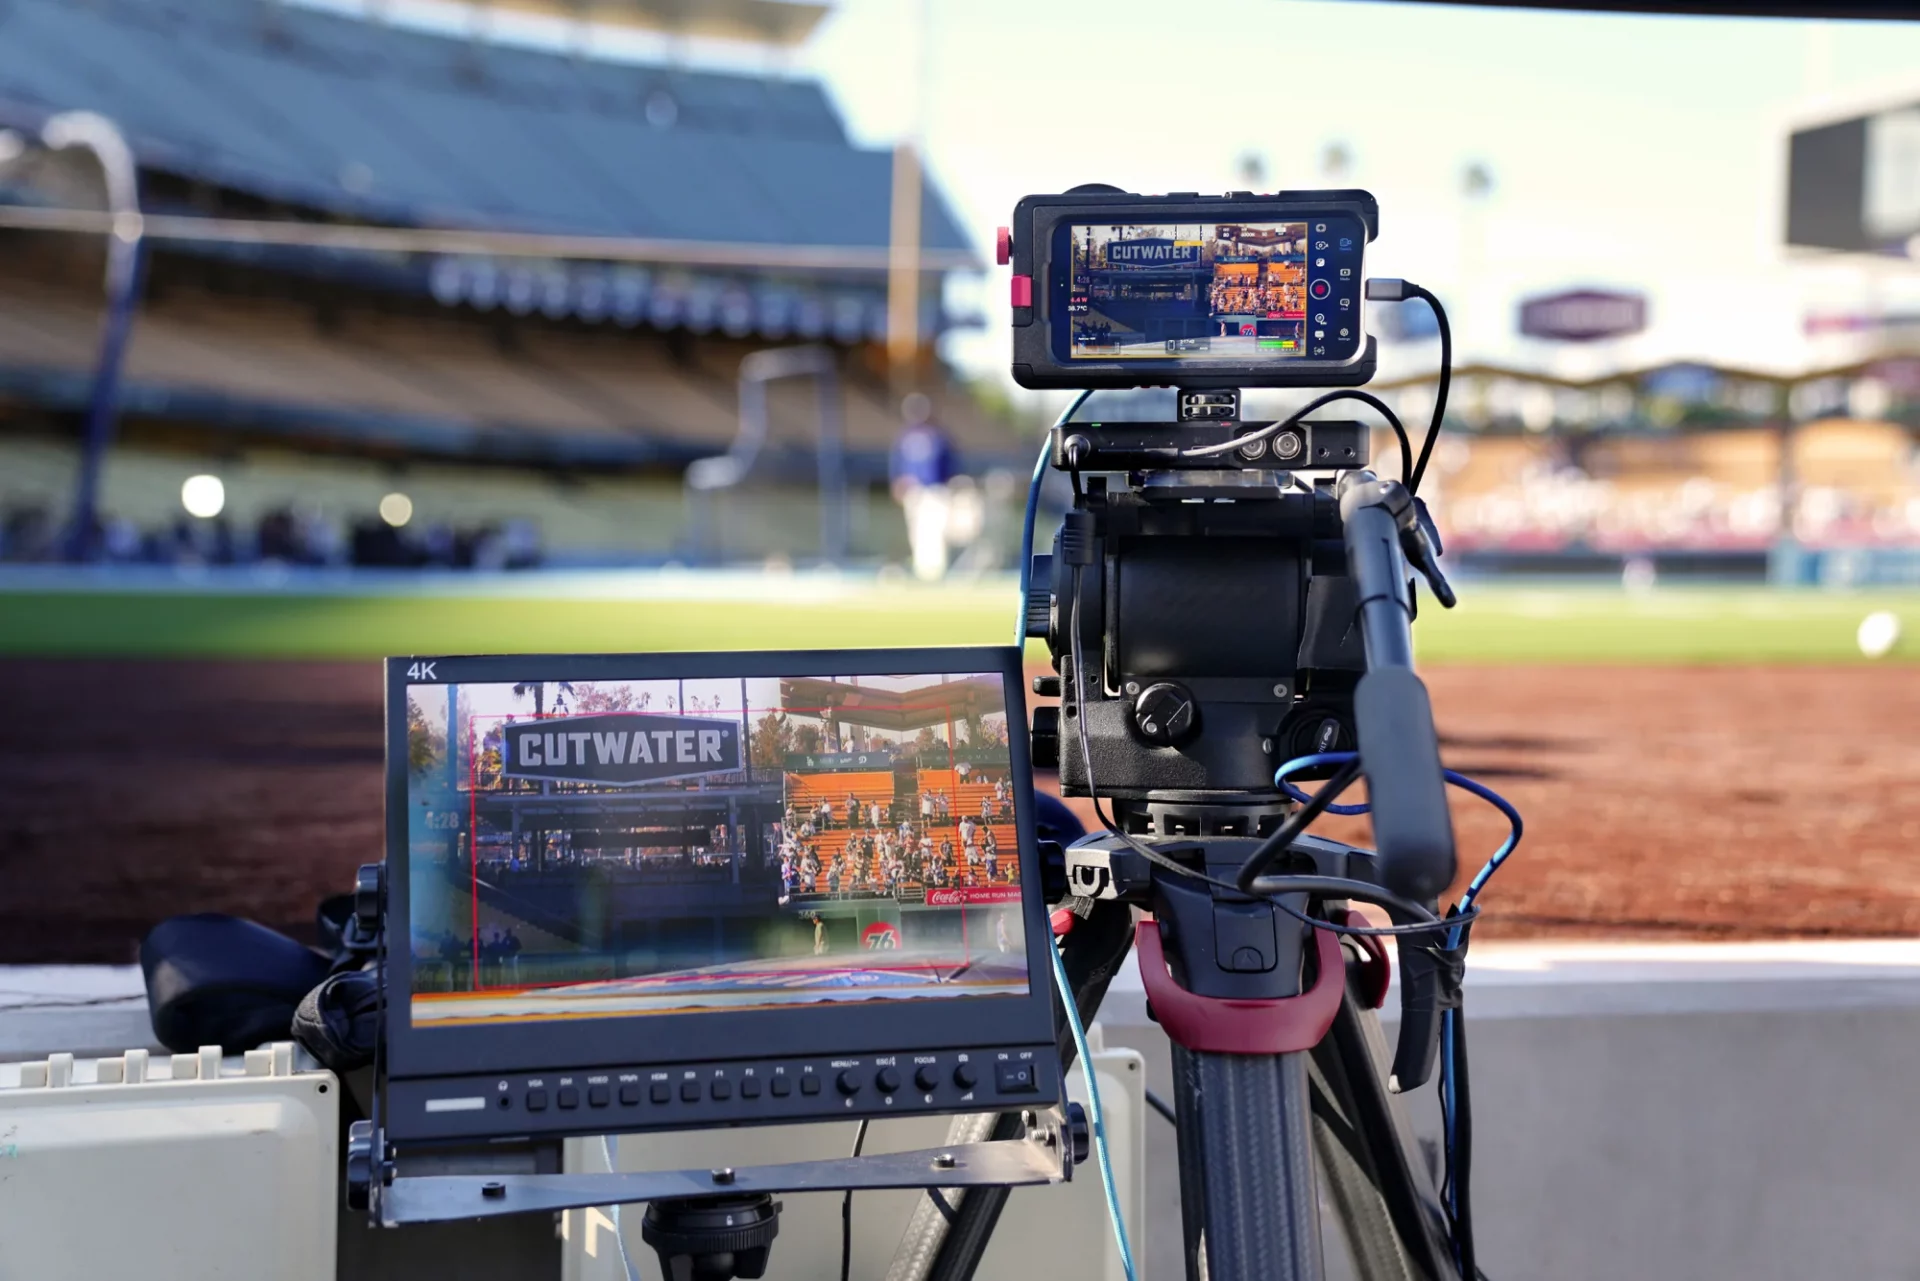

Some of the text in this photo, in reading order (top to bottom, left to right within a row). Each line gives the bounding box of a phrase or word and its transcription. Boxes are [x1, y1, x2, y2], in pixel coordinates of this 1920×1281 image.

[1112, 245, 1191, 260] CUTWATER
[406, 661, 438, 681] 4K
[518, 729, 723, 767] CUTWATER
[424, 810, 460, 829] 4:28
[931, 890, 967, 904] Coca-Co
[991, 891, 1006, 899] RUN
[866, 930, 896, 949] 76
[915, 1056, 936, 1064] FOCUS
[997, 1052, 1009, 1061] ON
[1019, 1051, 1033, 1060] OFF
[715, 1069, 724, 1078] F1
[745, 1067, 754, 1077] F2
[527, 1079, 544, 1088] VGA
[588, 1076, 609, 1084] VIDEO
